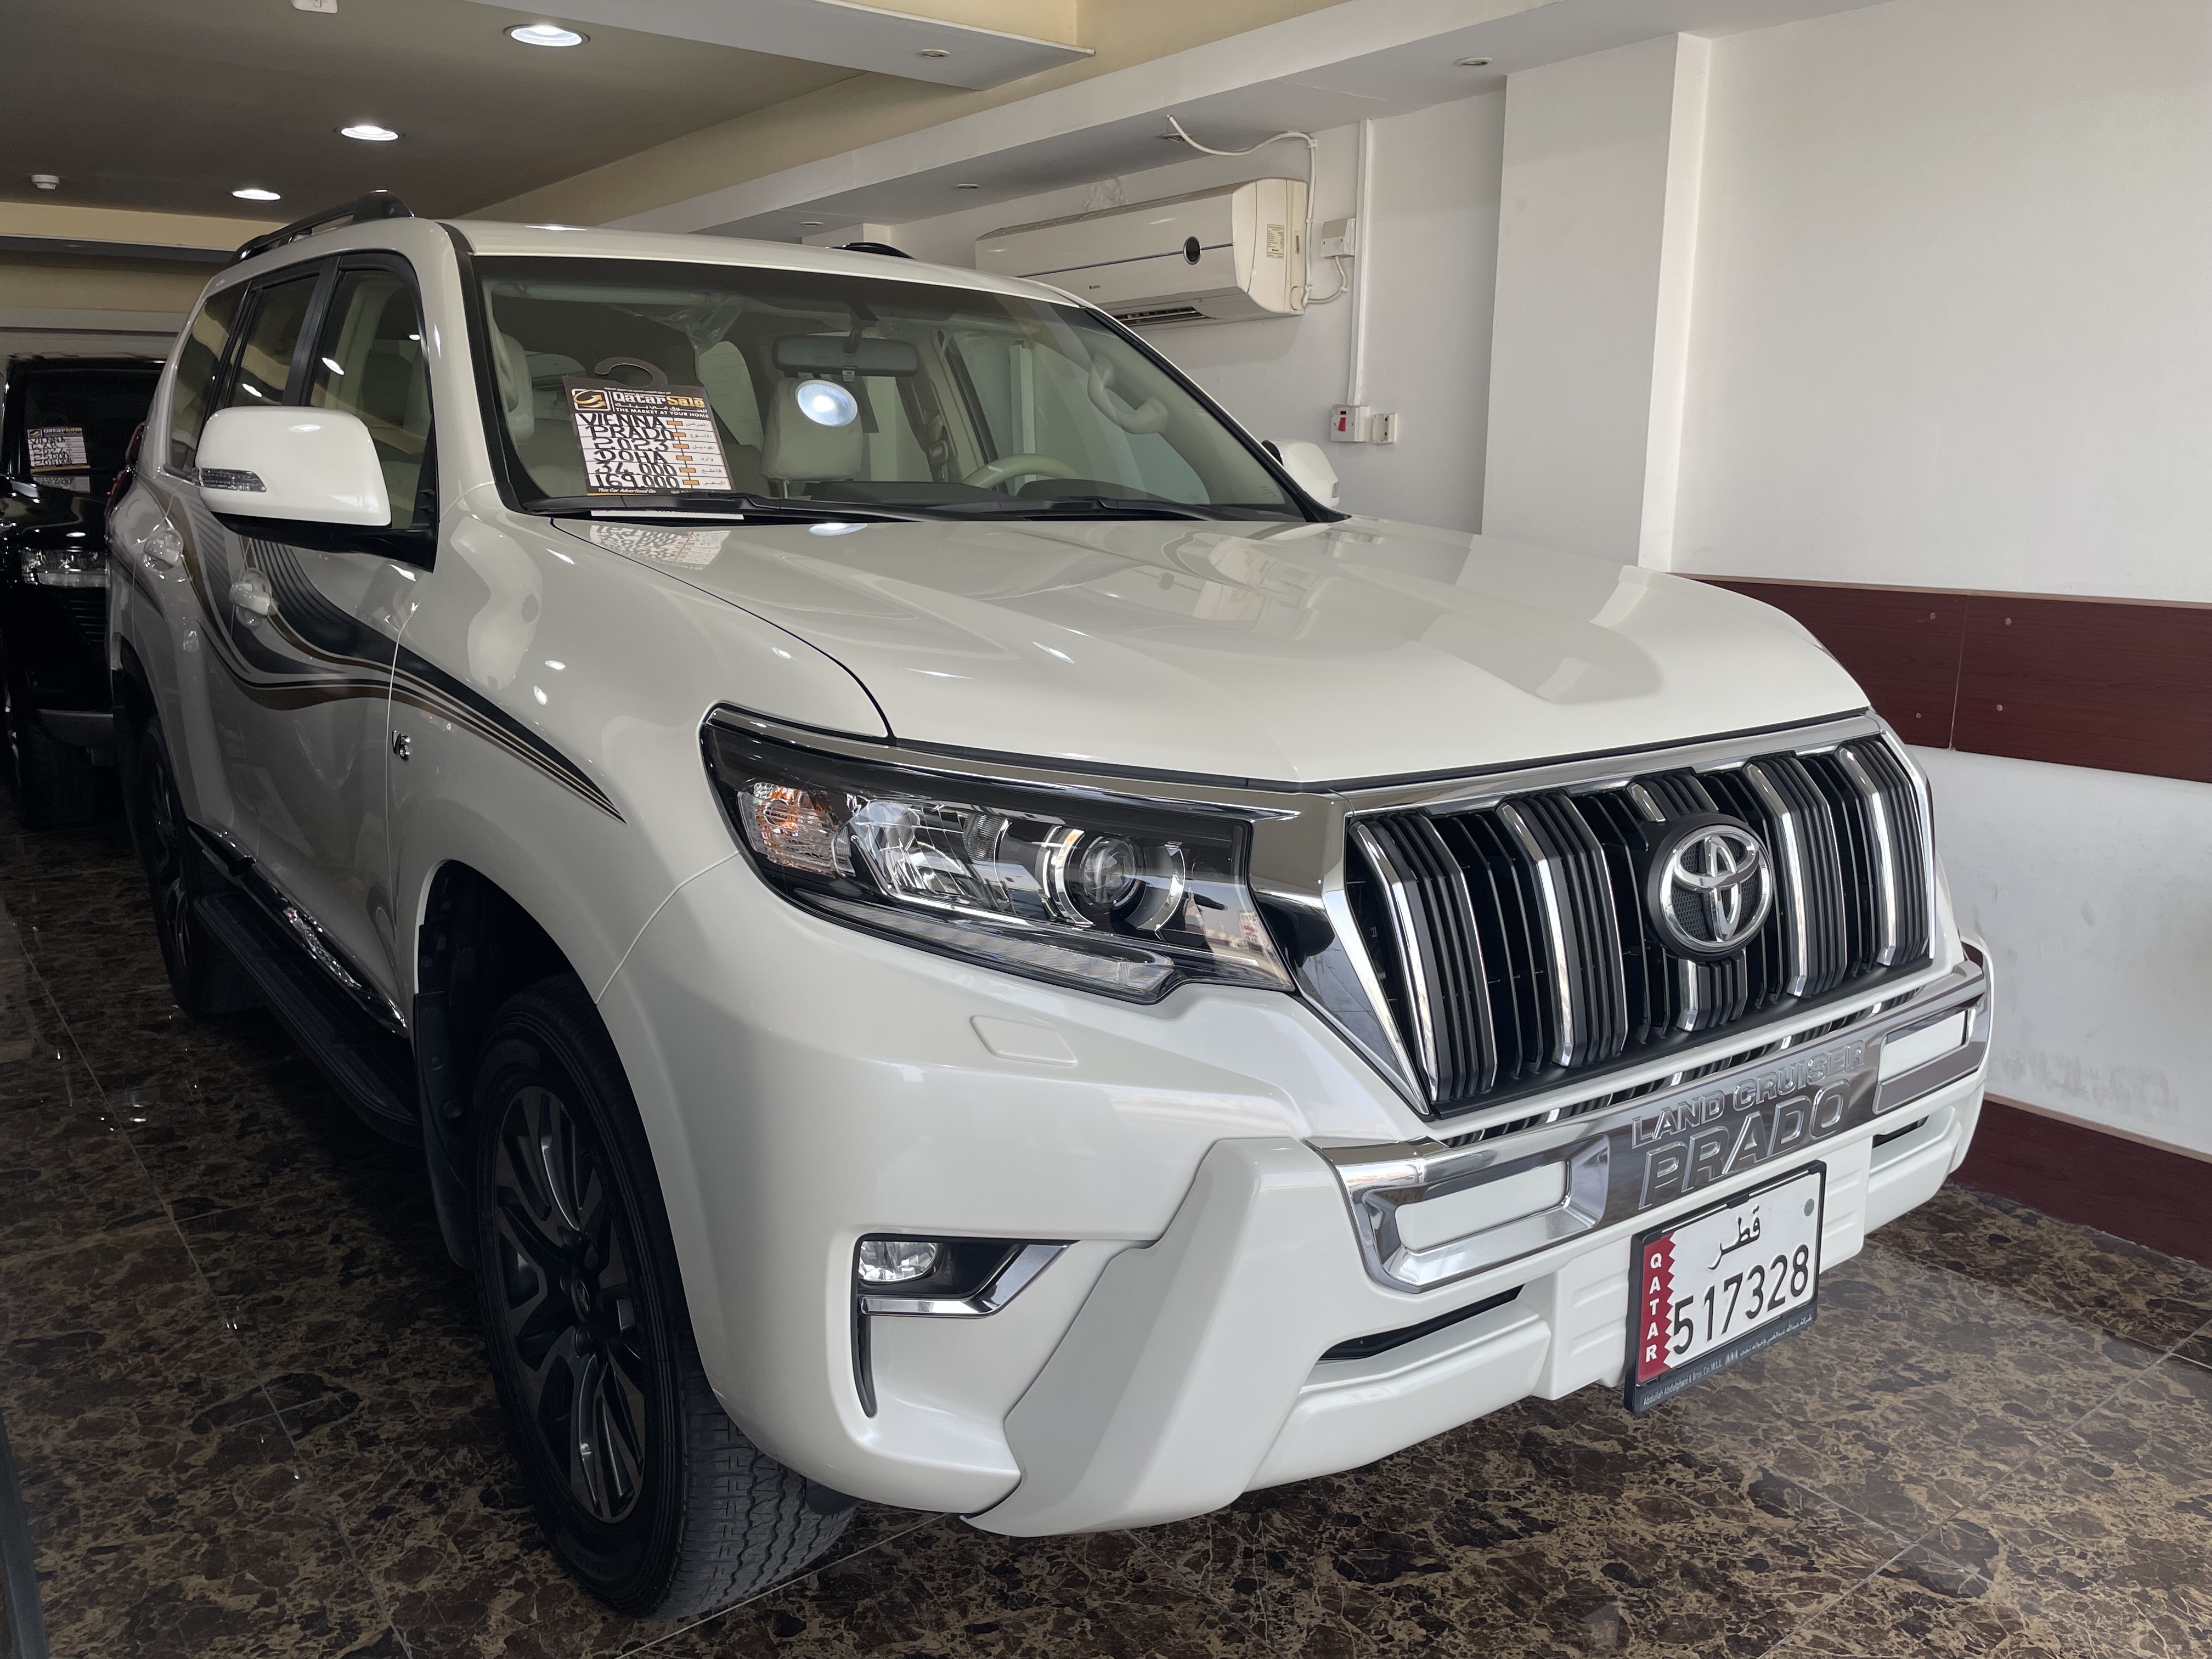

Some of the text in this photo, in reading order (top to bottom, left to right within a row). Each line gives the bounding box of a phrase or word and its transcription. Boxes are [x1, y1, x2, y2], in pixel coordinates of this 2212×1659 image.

[578, 413, 667, 429] VIENNA
[585, 425, 675, 441] PRADO
[592, 437, 669, 452] 2023
[593, 449, 668, 464] DOHA
[1632, 1040, 1865, 1149] LAND CRUISER
[1638, 1078, 1851, 1211] PRADO
[1707, 1205, 1761, 1271] قطر
[1646, 1252, 1662, 1363] QATAR
[1672, 1244, 1809, 1355] 517328
[1643, 1389, 1663, 1407] Abdullah
